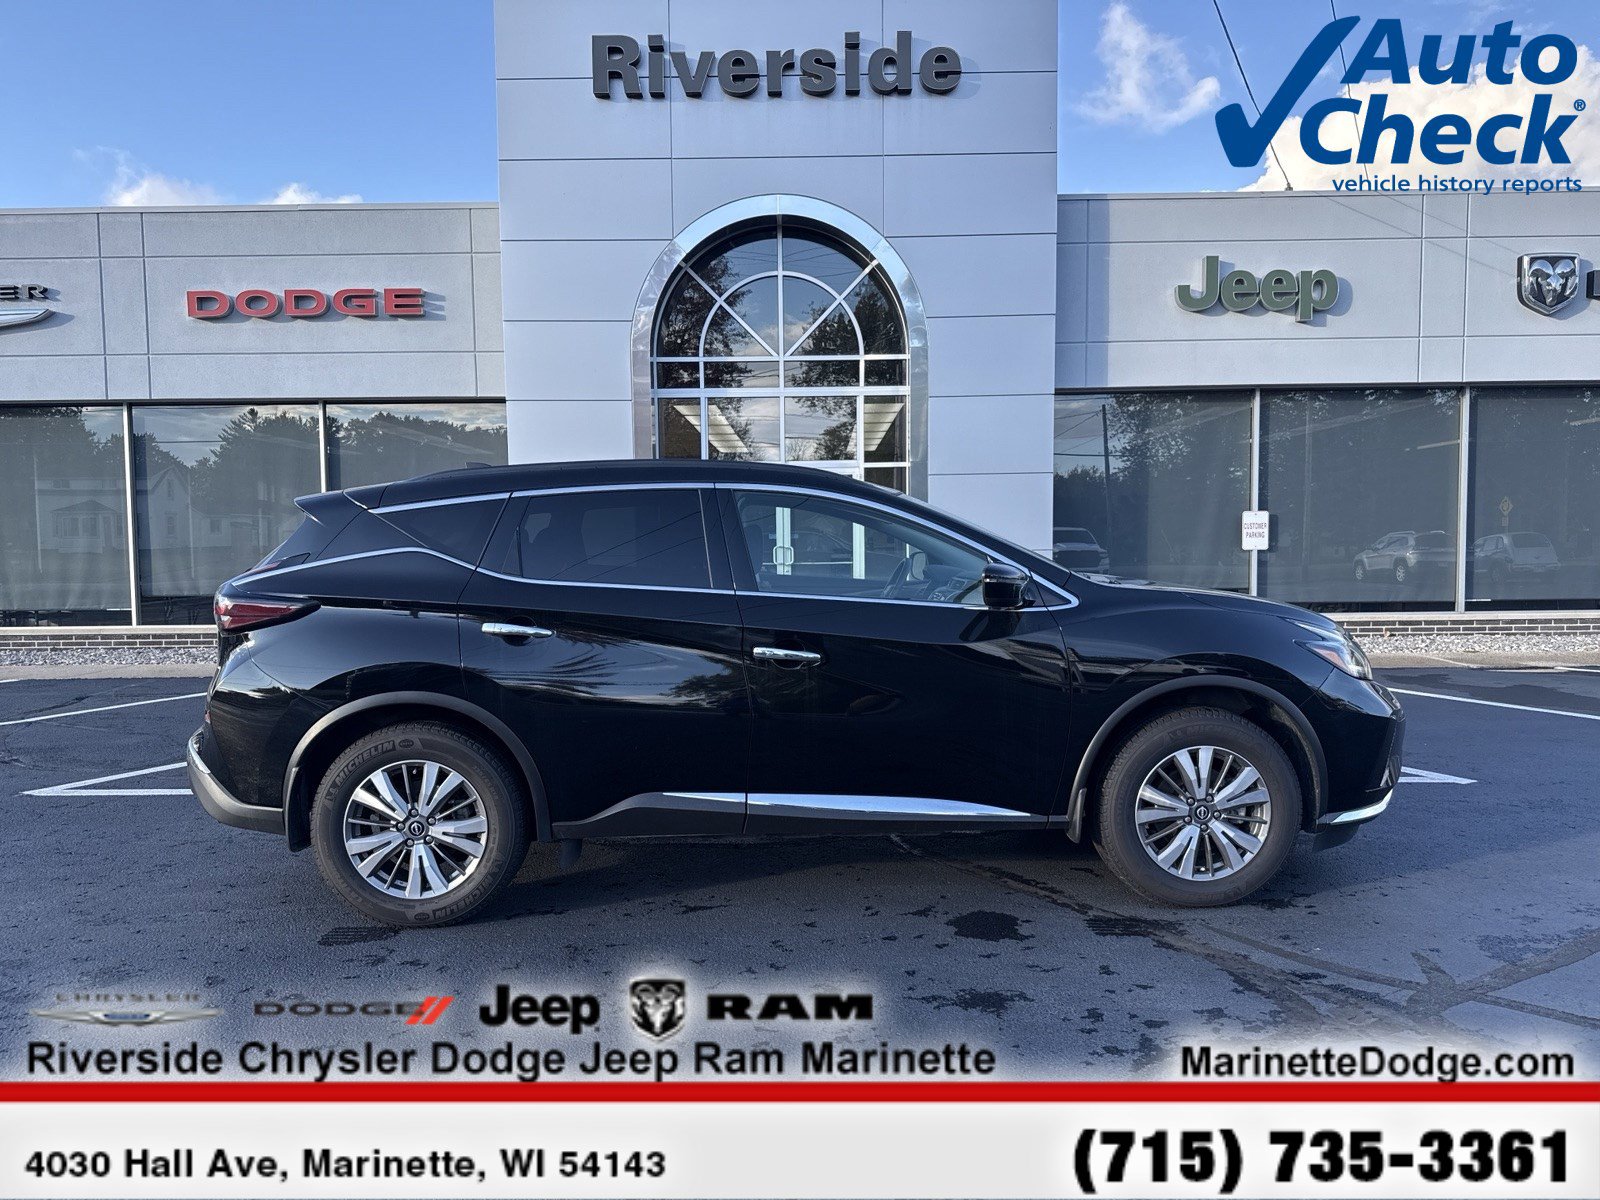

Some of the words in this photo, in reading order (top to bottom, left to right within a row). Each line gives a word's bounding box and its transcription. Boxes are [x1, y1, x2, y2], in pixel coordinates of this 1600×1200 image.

[591, 31, 962, 99] Riverside
[187, 288, 426, 318] DODGE
[1174, 255, 1339, 322] Jeep
[1243, 522, 1267, 530] CUSTOMER
[1245, 531, 1265, 539] PARKING
[336, 740, 395, 786] MICHELIN
